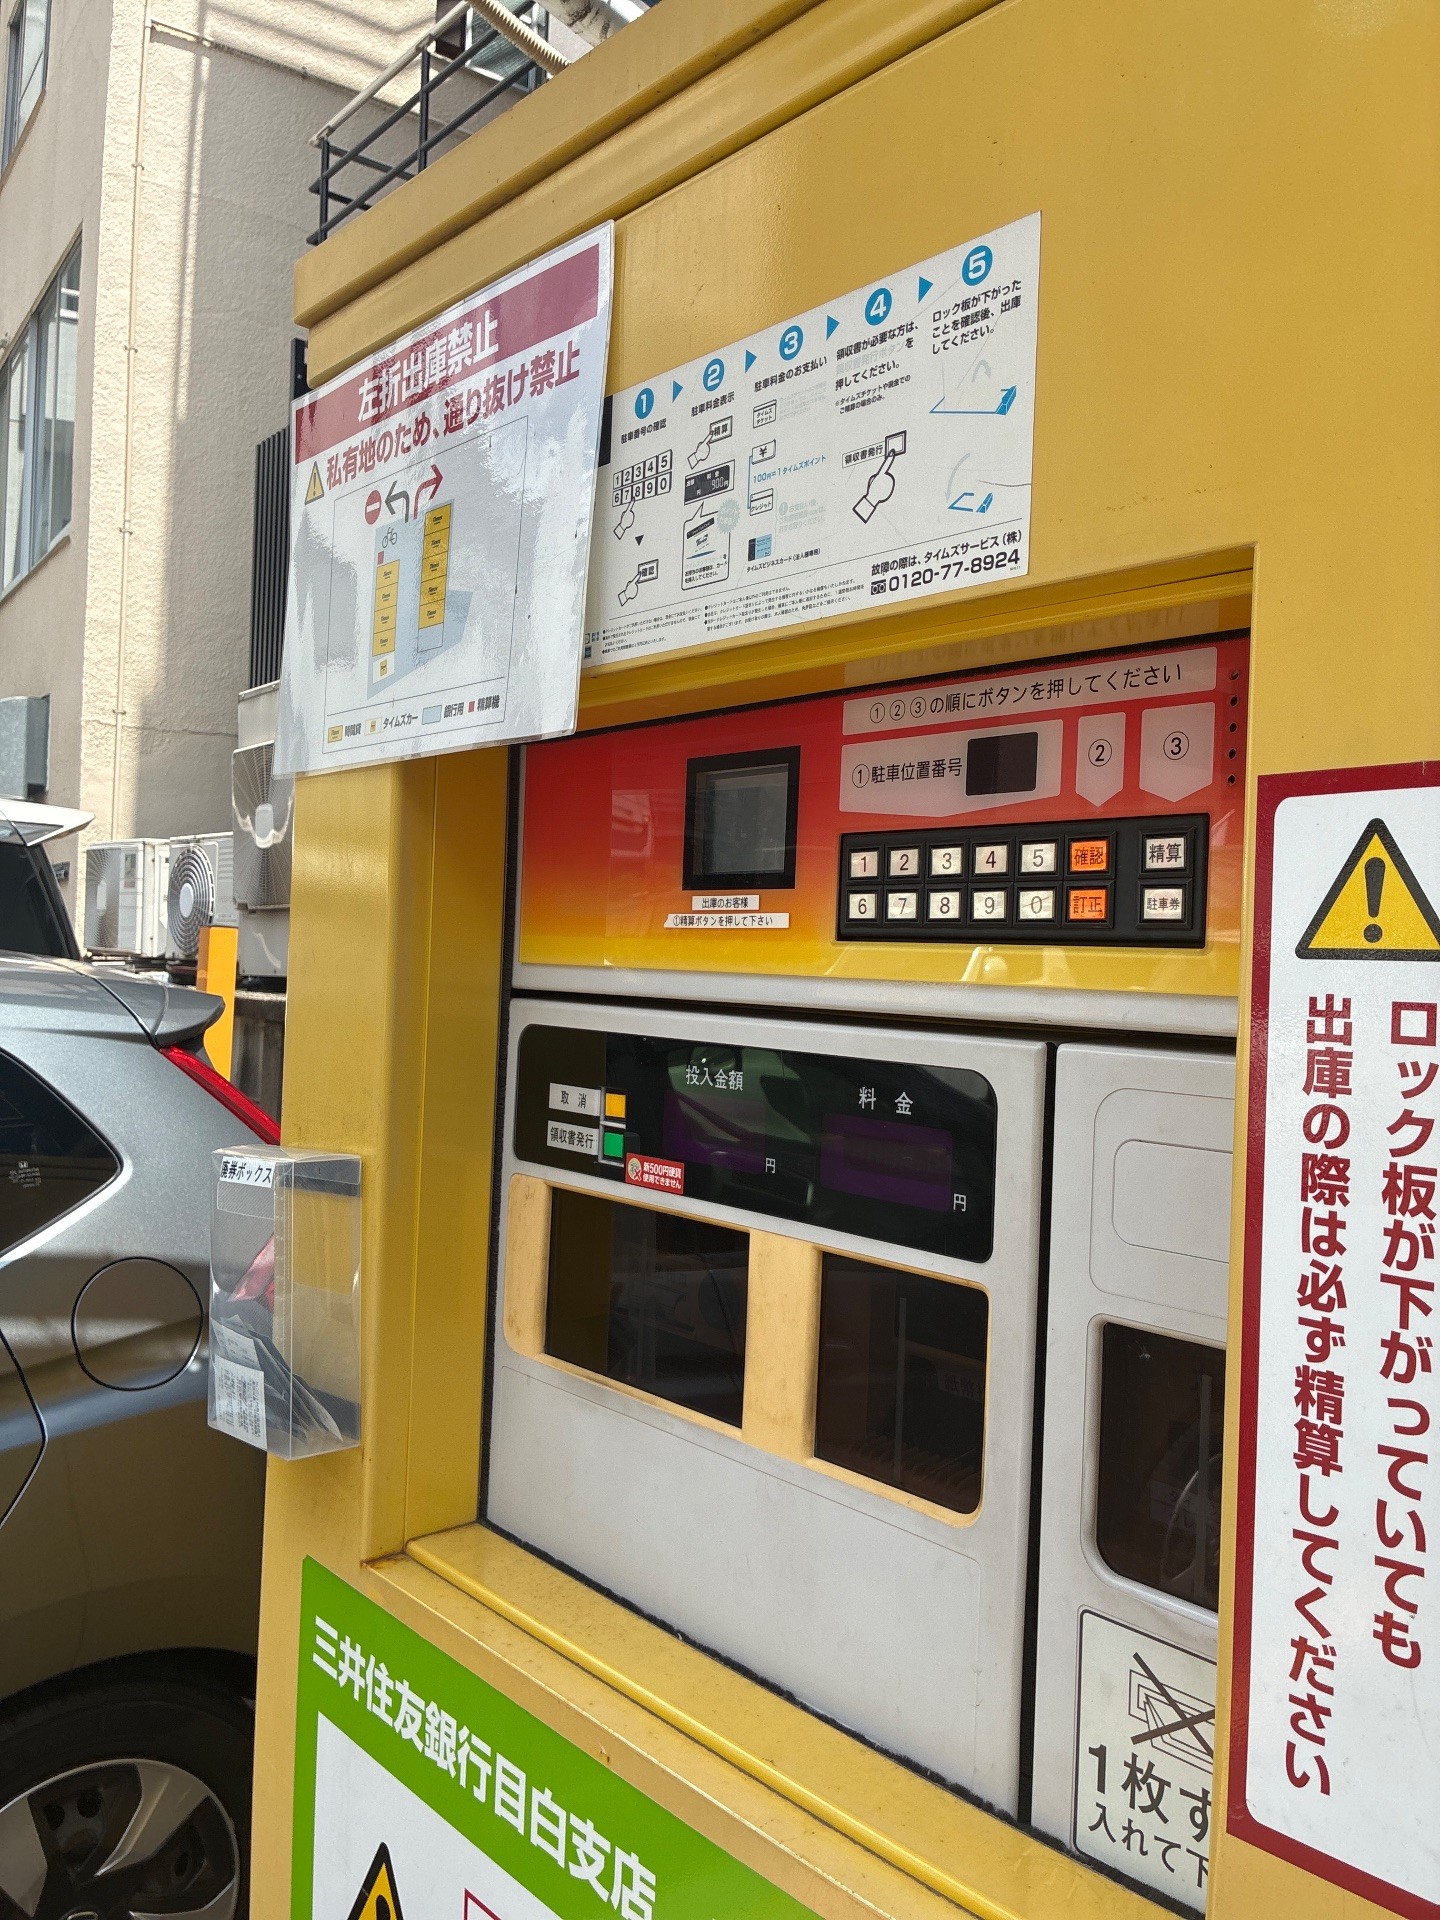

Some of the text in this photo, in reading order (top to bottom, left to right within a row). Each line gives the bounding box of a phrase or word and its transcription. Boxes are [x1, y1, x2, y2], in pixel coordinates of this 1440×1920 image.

[932, 280, 1021, 322] ロック板が下がった
[932, 295, 1021, 338] ことを確認後、出庫
[836, 321, 918, 361] 領収書が必要な方は、
[932, 325, 995, 354] してください。
[357, 310, 499, 423] 左折出庫禁止
[754, 356, 827, 393] 駐車料金のお支払い
[835, 360, 899, 391] 押してください。
[326, 340, 581, 491] 私有地のため、通り抜け禁止
[691, 391, 735, 417] 駐車料金表示
[757, 408, 773, 418] タイムズ
[621, 418, 667, 444] 駐車番号の確認
[625, 471, 631, 479] 2
[635, 467, 642, 477] 3
[647, 461, 654, 473] 4
[661, 455, 668, 468] 5
[845, 445, 883, 465] 領収書発行
[614, 477, 667, 503] 6 7 8 9 0
[889, 549, 1020, 591] 0120-77-8924
[383, 713, 419, 730] タイムズカー
[860, 842, 1182, 873] 1 2 3 4 5 確認 精算
[701, 897, 749, 909] 出庫のお客様
[858, 895, 1180, 915] 6 7 8 9 0 訂正 駐車券
[685, 1065, 744, 1091] 投入金額
[550, 1127, 594, 1148] 領収書発行
[220, 1160, 273, 1184] 廃券ボックス
[643, 1162, 682, 1179] 新500円硬貨
[764, 1158, 776, 1174] 円
[643, 1173, 681, 1189] 使用できません
[953, 1193, 967, 1212] 円
[1372, 1000, 1439, 1669] ロック板が下がっていても
[1286, 994, 1352, 1796] 出庫の際は必ず精算してください
[312, 1615, 657, 1920] 三井住友銀行目白支店
